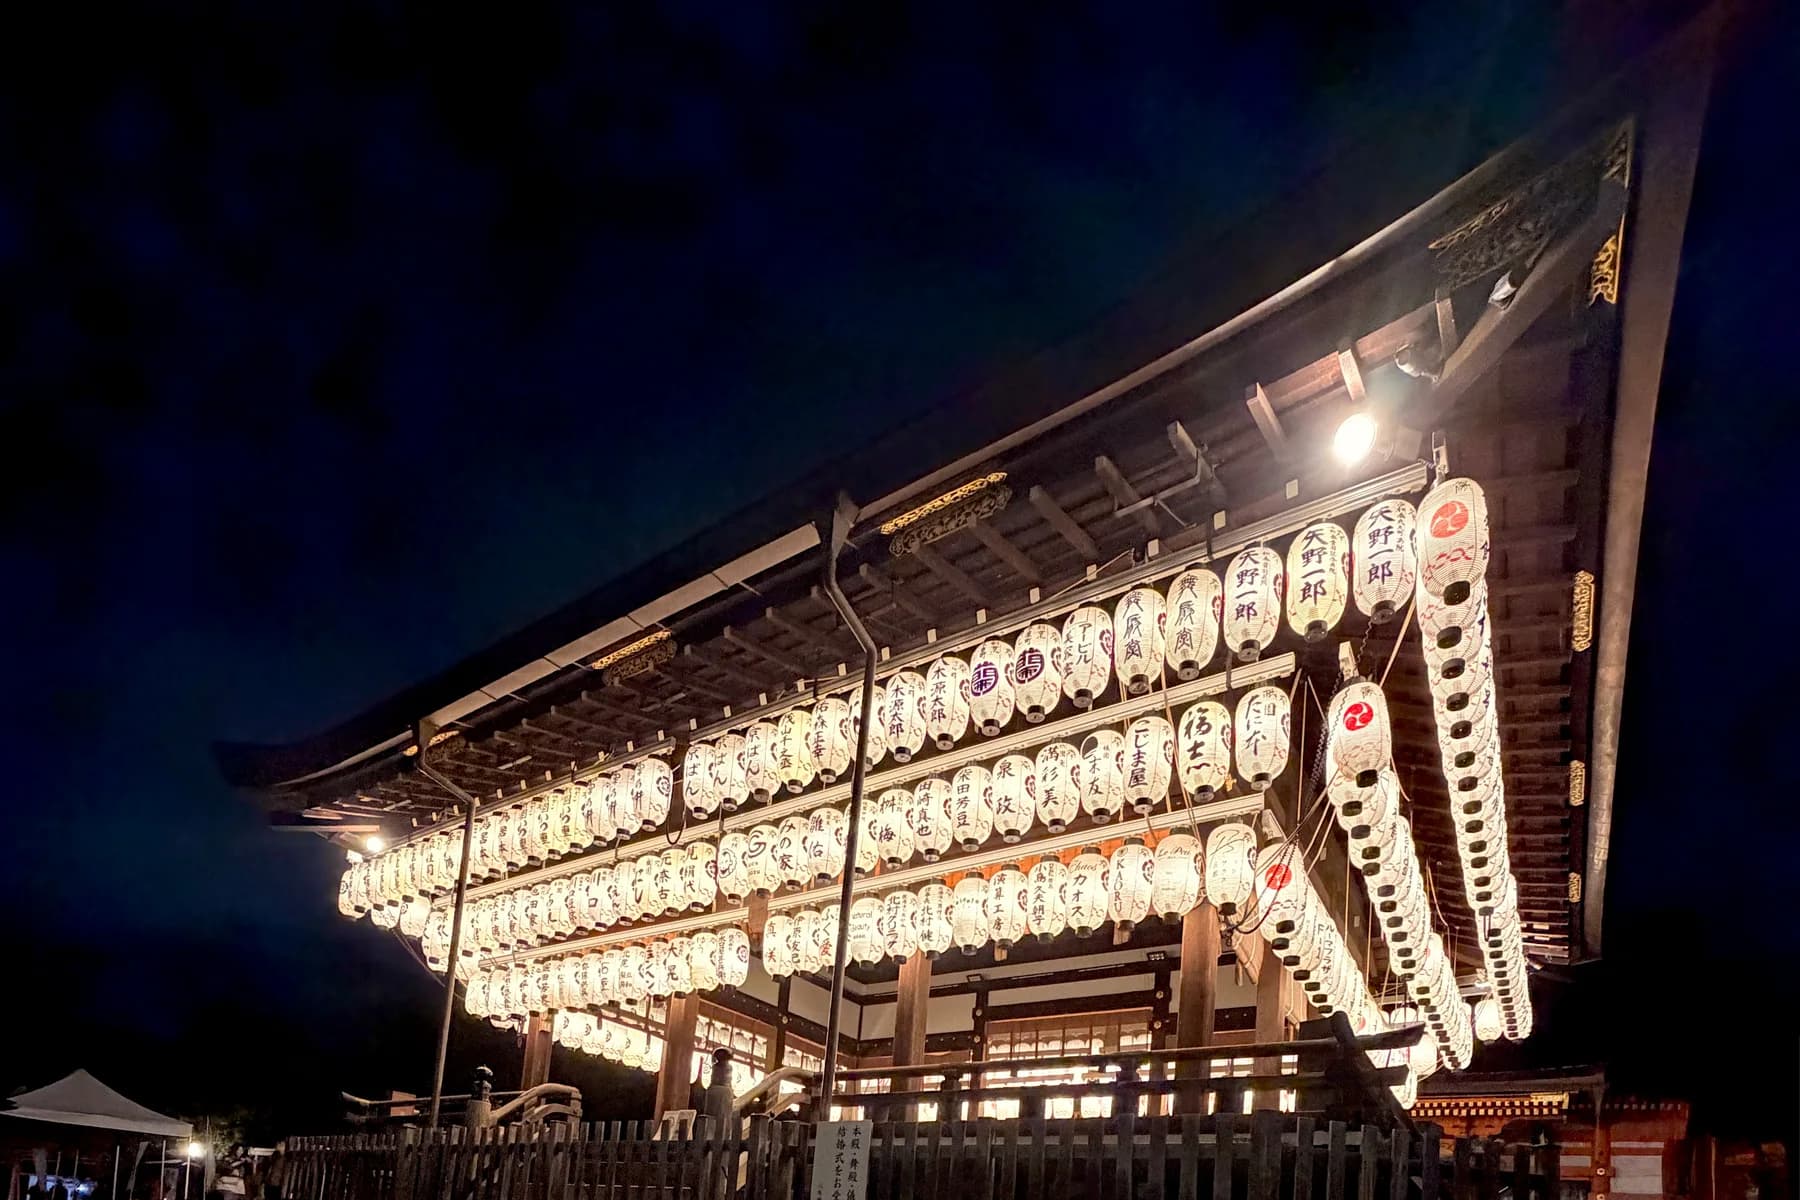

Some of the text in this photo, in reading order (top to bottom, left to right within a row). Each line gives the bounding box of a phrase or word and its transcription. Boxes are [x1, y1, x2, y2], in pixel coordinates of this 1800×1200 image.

[1128, 719, 1150, 788] こじま屋
[779, 819, 796, 871] みの家
[1071, 873, 1088, 918] カオス
[1113, 858, 1125, 913] KAORU
